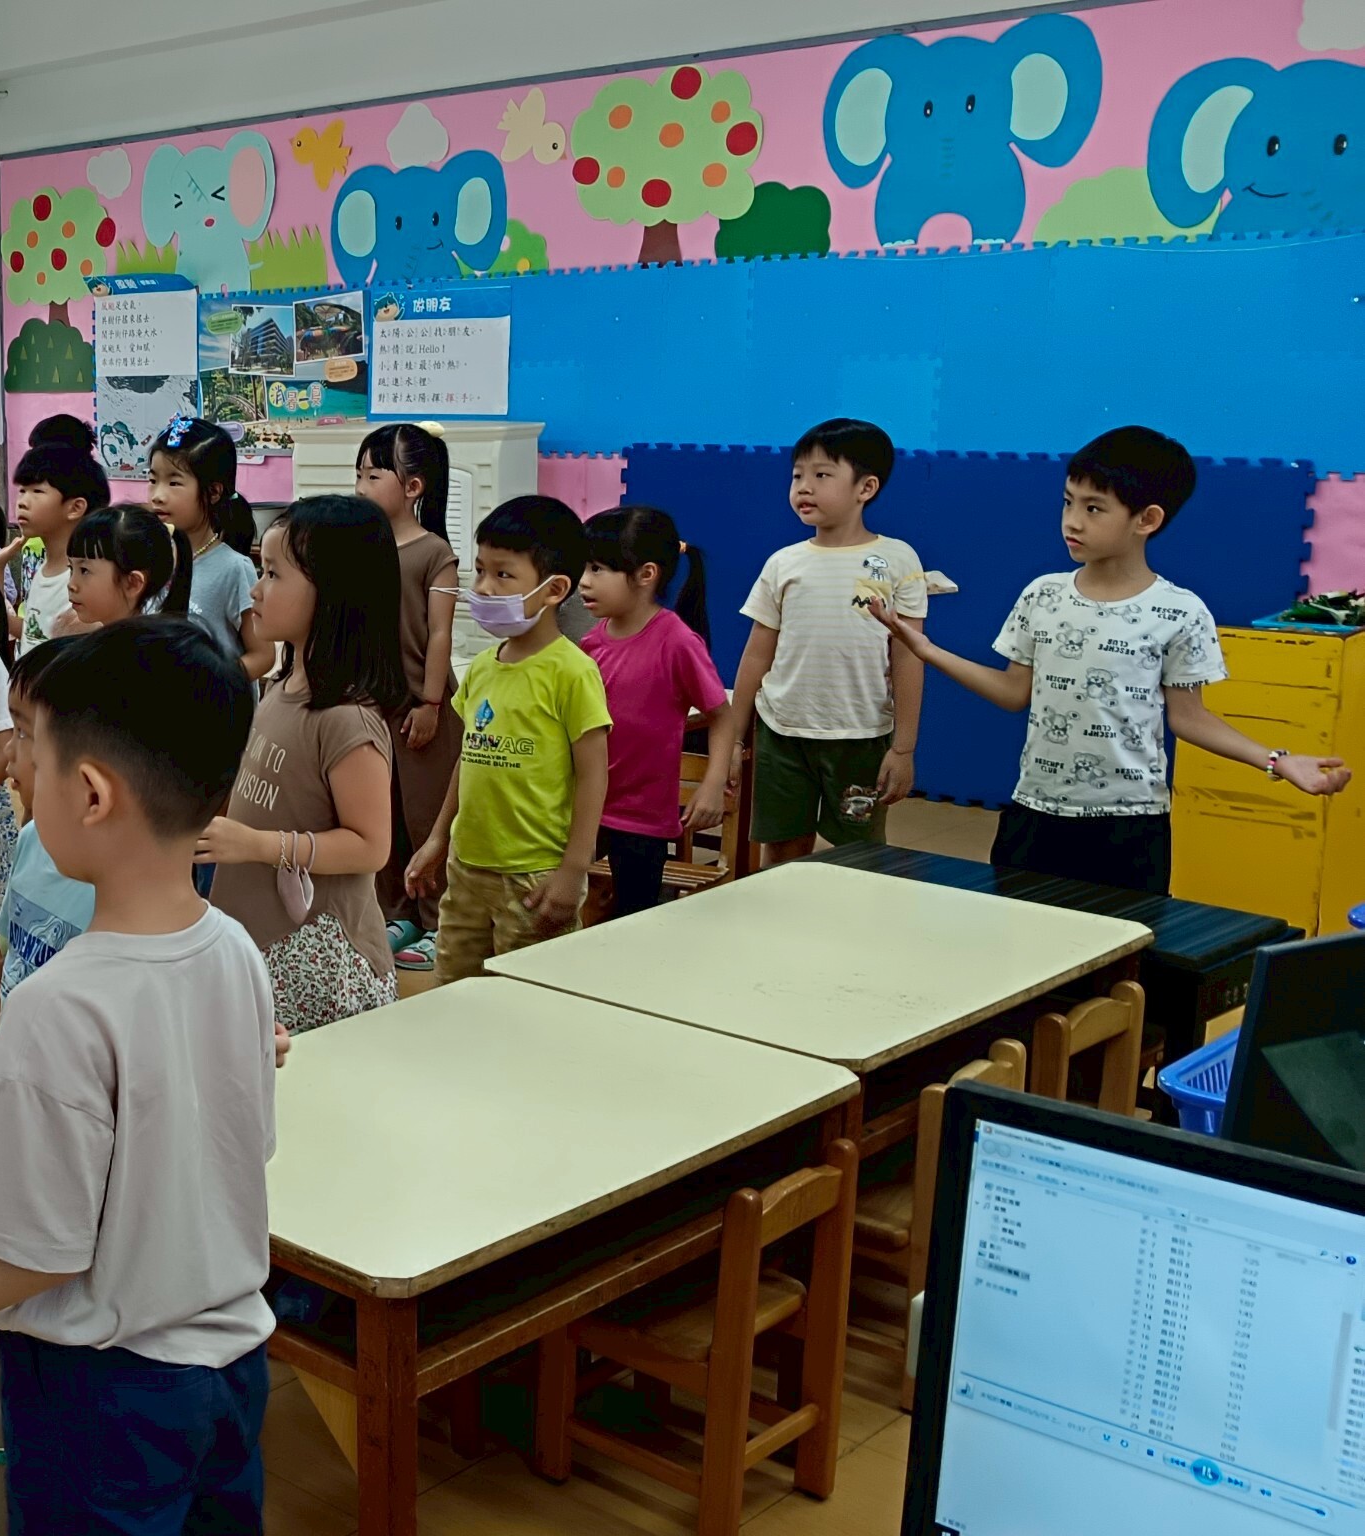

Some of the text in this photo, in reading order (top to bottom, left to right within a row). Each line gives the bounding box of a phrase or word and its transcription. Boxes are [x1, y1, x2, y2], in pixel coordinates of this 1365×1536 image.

[413, 297, 451, 312] 做朋友
[265, 742, 286, 773] TO
[237, 768, 280, 811] VISION
